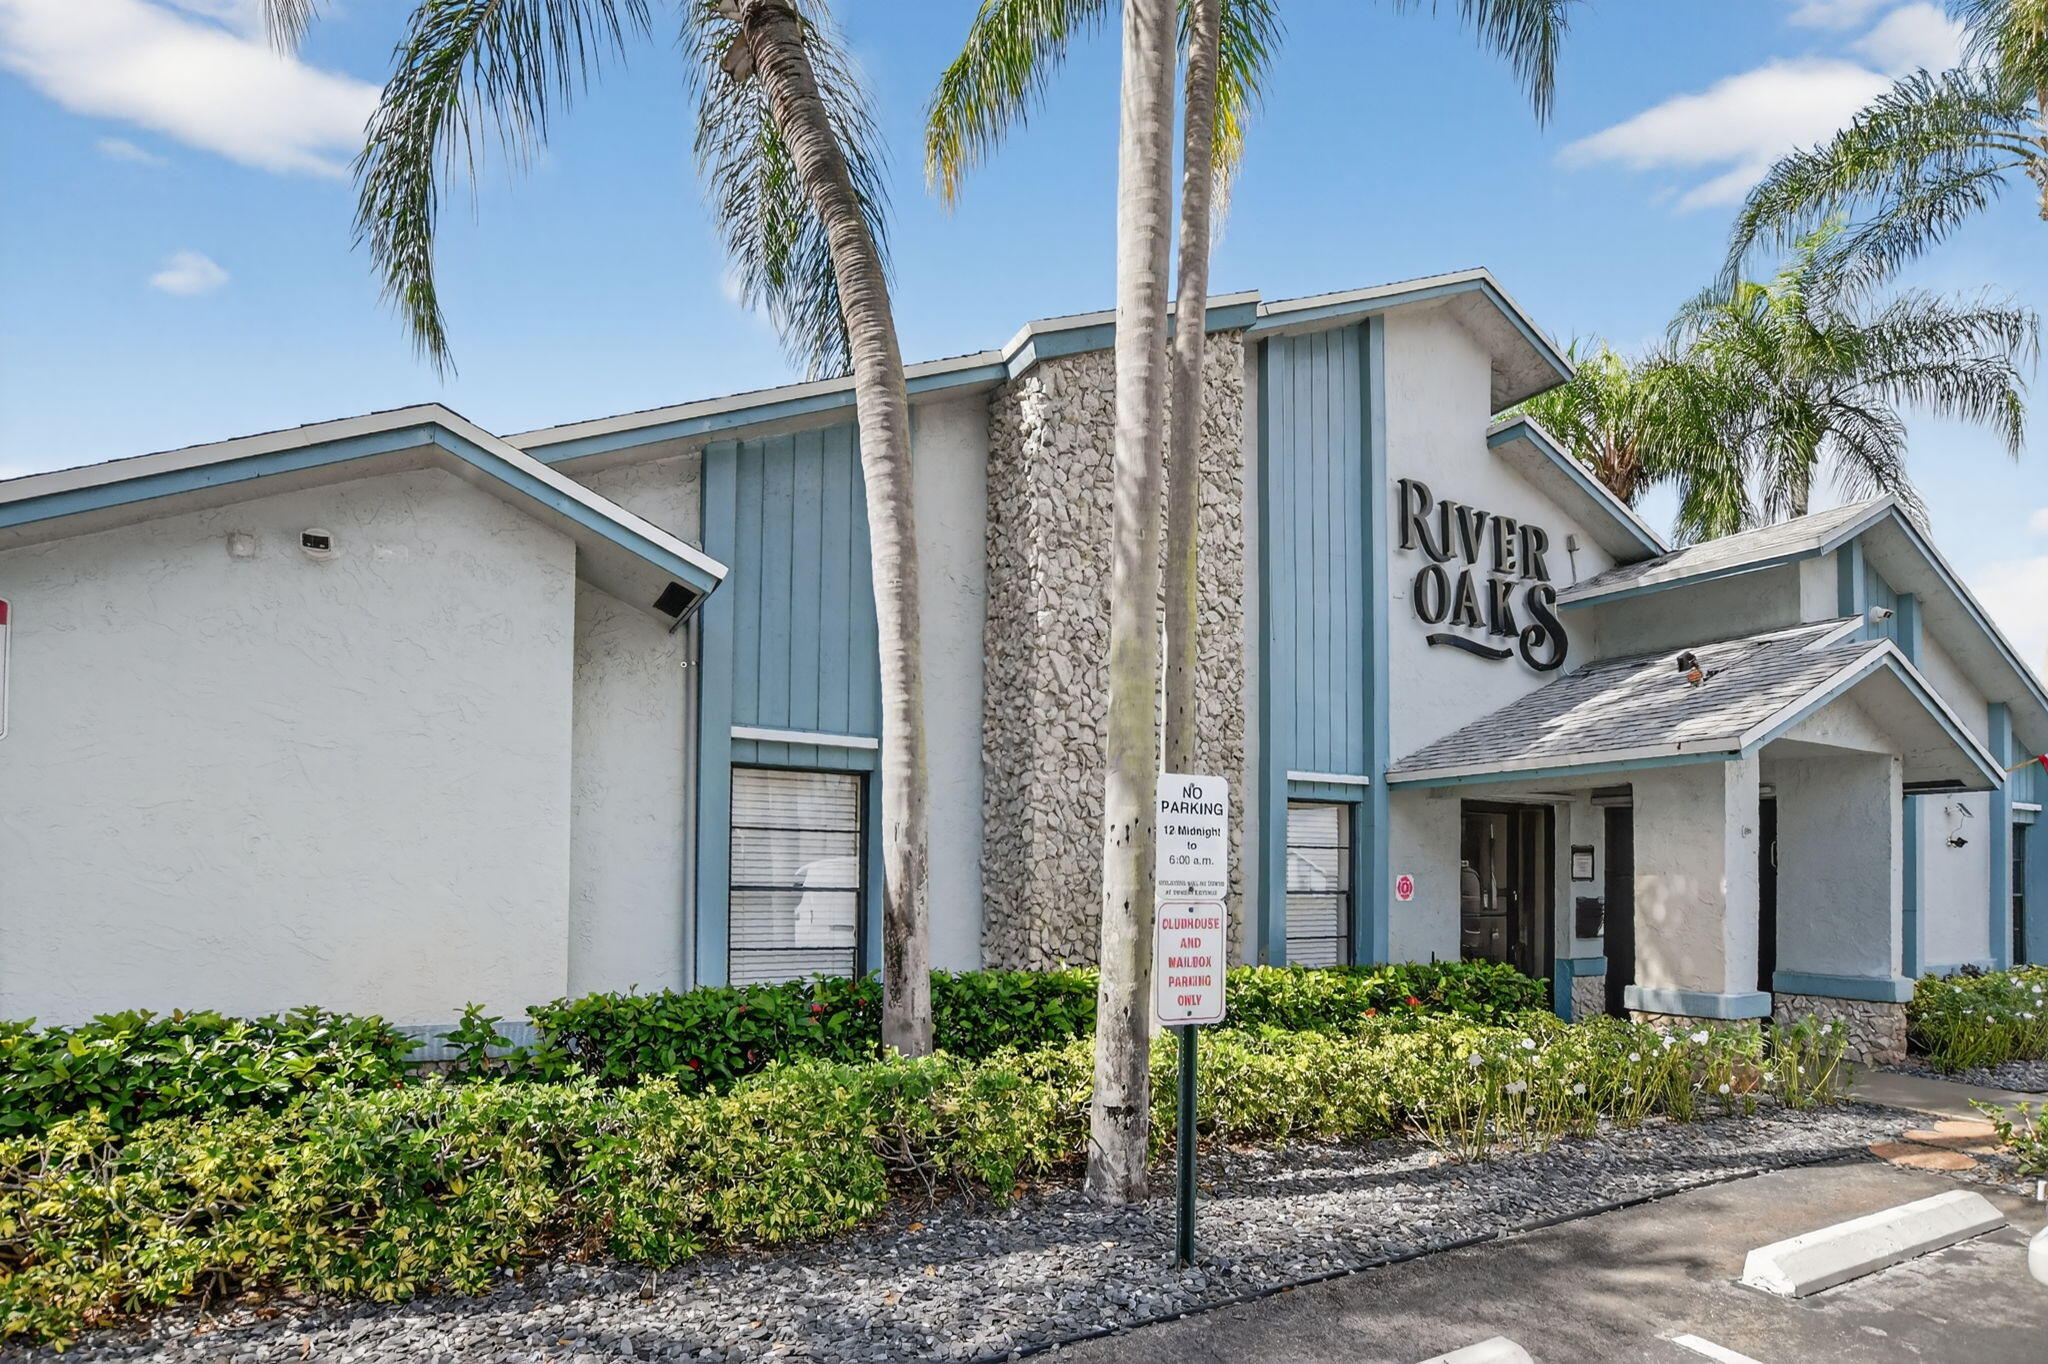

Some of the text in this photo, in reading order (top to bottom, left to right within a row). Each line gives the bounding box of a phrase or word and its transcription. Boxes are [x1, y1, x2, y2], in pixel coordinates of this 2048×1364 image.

[1397, 478, 1551, 581] RIVER
[1413, 563, 1568, 671] OAKS
[1182, 785, 1203, 800] NO
[1161, 800, 1224, 816] PARKING
[1164, 825, 1221, 839] 12 Midnight
[1187, 842, 1198, 851] to
[1169, 855, 1214, 866] 6:00 a.m.
[1177, 994, 1202, 1007] ONLY
